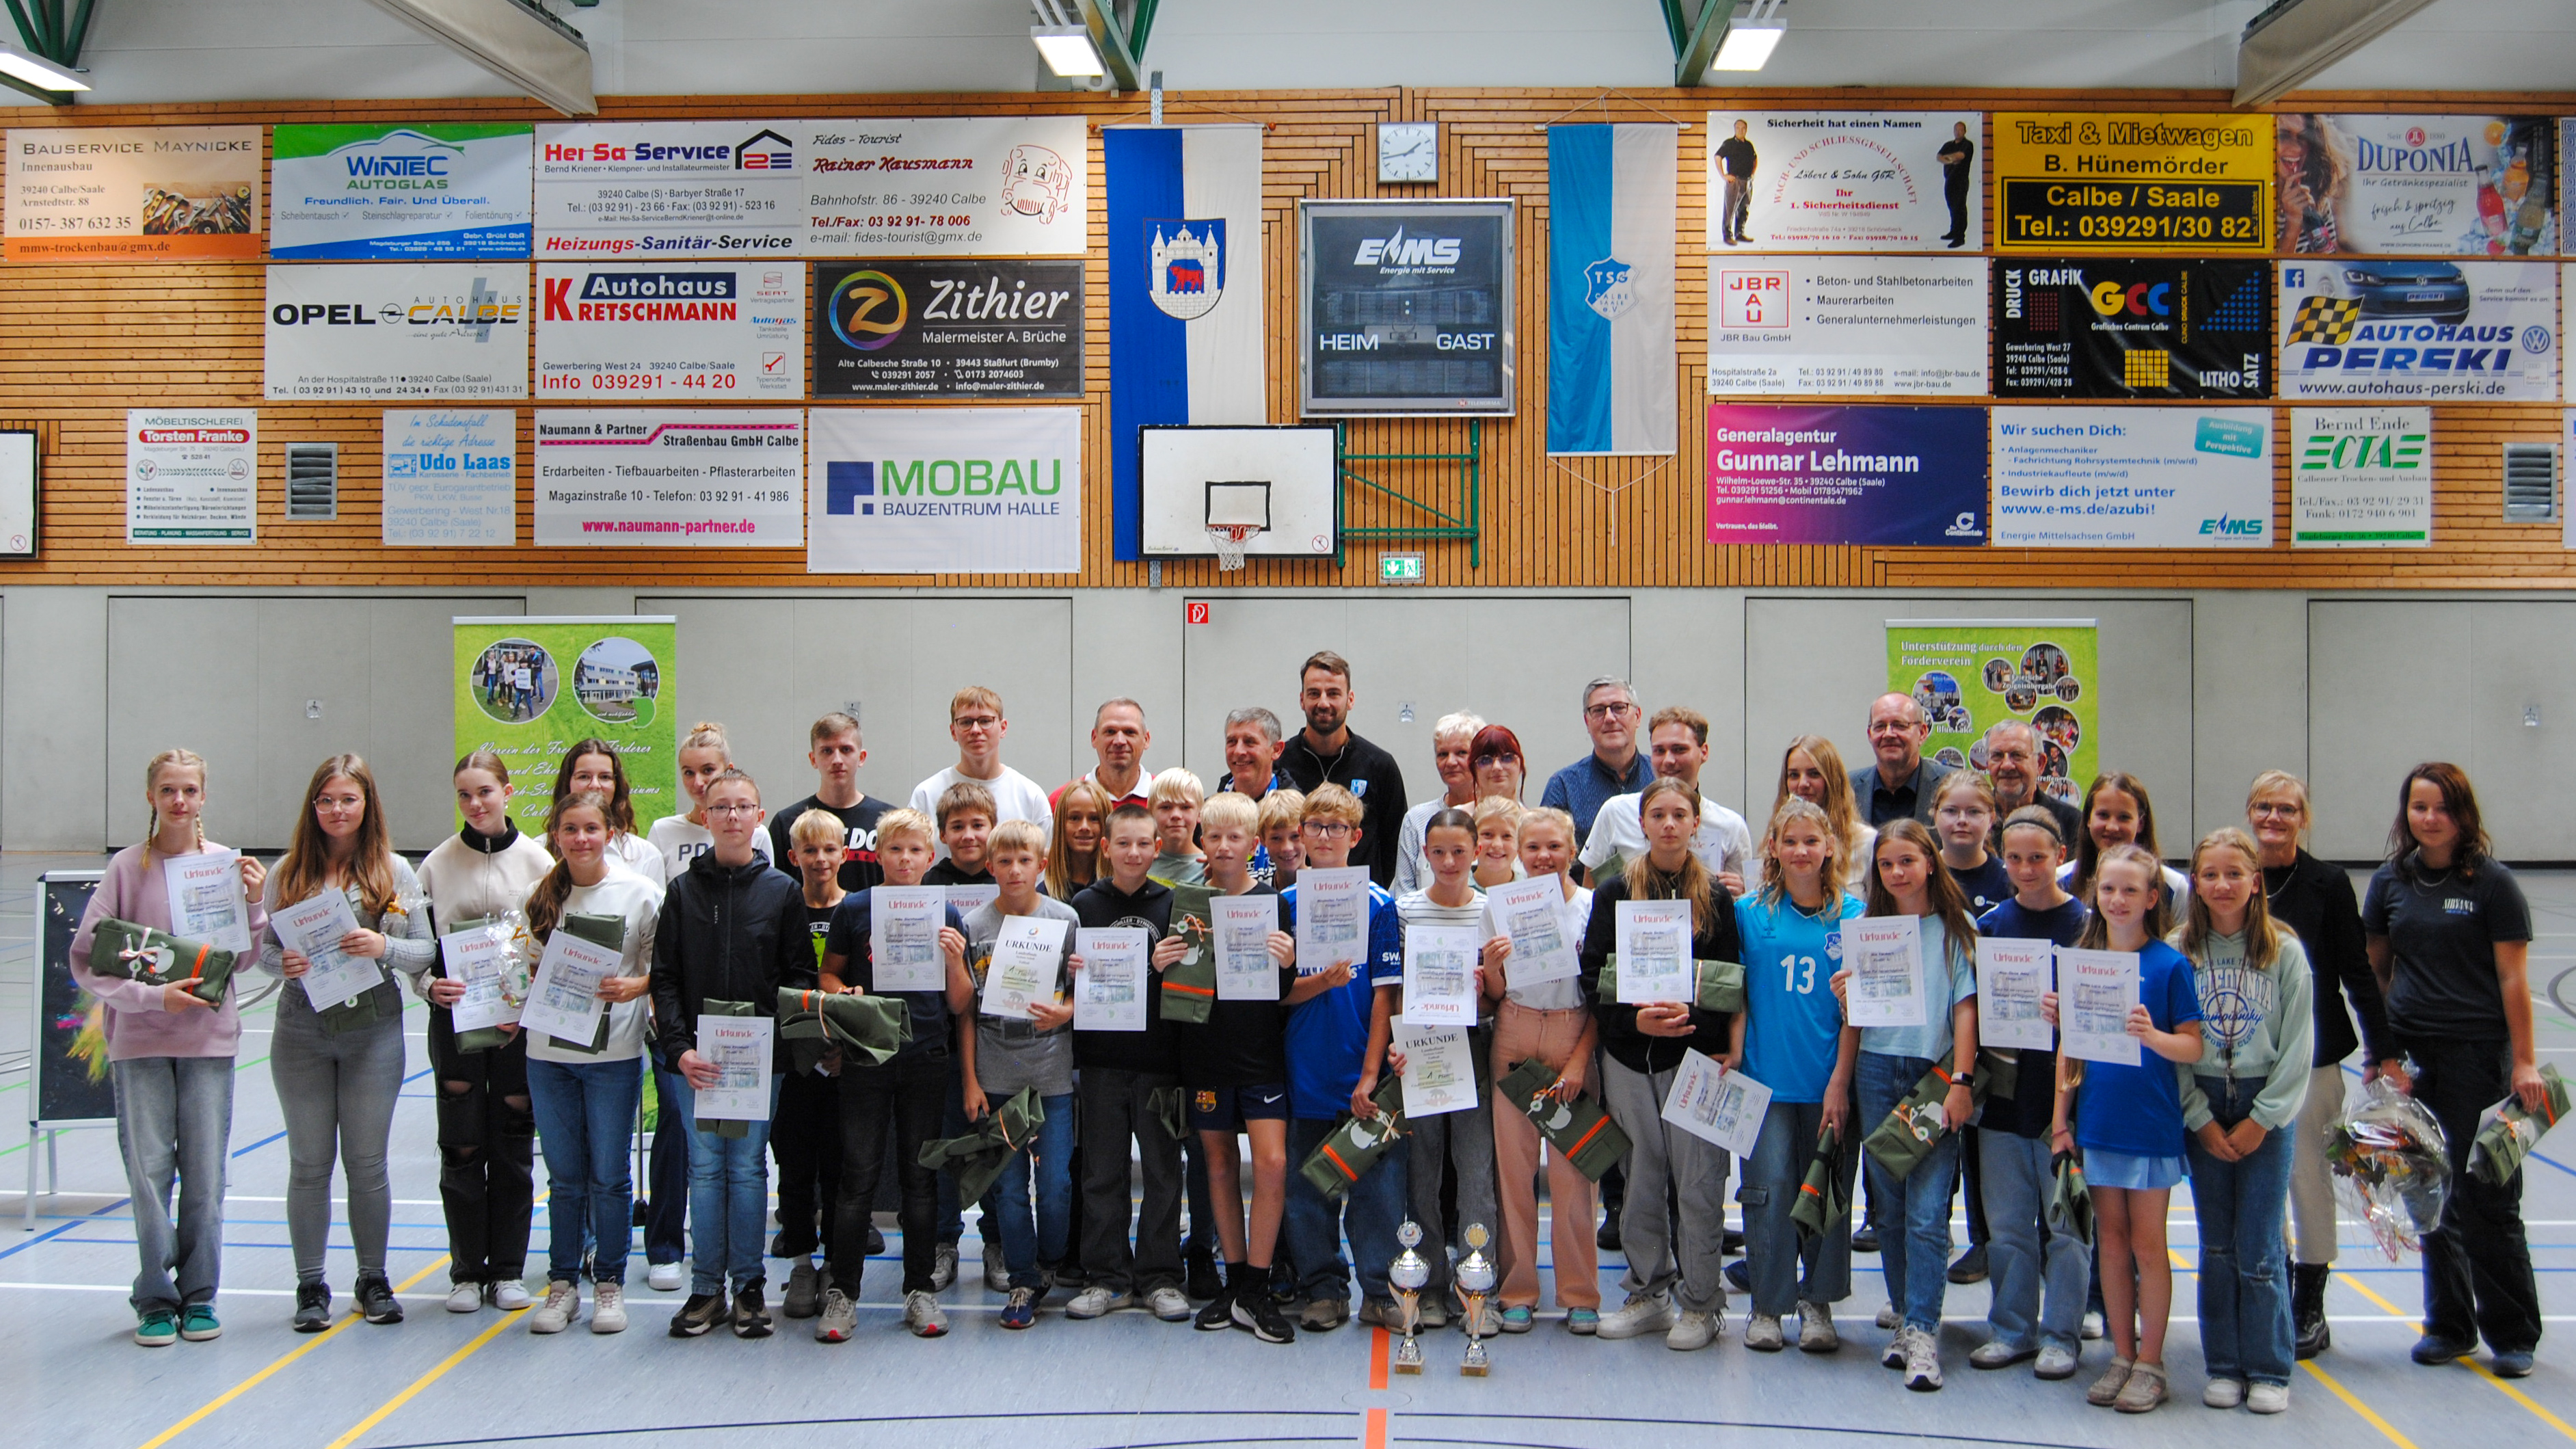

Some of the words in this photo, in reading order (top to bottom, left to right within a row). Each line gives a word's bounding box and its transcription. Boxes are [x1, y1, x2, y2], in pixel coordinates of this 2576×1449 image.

[1767, 120, 1824, 128] Sicherheit
[2016, 122, 2071, 145] Taxi
[2079, 123, 2101, 145] &
[2108, 122, 2253, 151] Mietwagen
[23, 143, 144, 155] BAUSERVICE
[155, 141, 252, 152] MAYNICKE
[2357, 136, 2476, 172] DUPONIA
[22, 162, 93, 172] Innenausbau
[813, 157, 875, 174] Rainer
[2044, 155, 2067, 172] B.
[2078, 155, 2228, 174] Hünemörder
[21, 186, 47, 194] 39240
[51, 185, 105, 194] Calbe/Saale
[347, 179, 448, 189] AUTOGLAS
[305, 197, 373, 205] Freundlich.
[443, 195, 489, 204] Überall.
[598, 190, 623, 198] 39240
[626, 189, 649, 198] Calbe
[651, 189, 662, 199] (S)
[669, 189, 702, 198] Barbyer
[705, 189, 732, 197] Straße
[735, 189, 744, 197] 17
[281, 211, 339, 220] Scheibentausch
[362, 211, 442, 220] Steinschlagreparatur
[546, 235, 792, 252] Heizungs-Sanitär-Service
[810, 233, 850, 243] e-mail:
[854, 231, 982, 244] fides-tourist@gmx.de
[1595, 271, 1628, 284] TSG
[1817, 276, 1851, 287] Beton-
[1854, 276, 1873, 287] und
[1877, 276, 1973, 287] Stahlbetonarbeiten
[2028, 269, 2082, 285] GRAFIK
[590, 276, 727, 296] Autohaus
[544, 278, 736, 321] KRETSCHMANN
[924, 276, 1069, 319] Zithier
[1817, 295, 1894, 306] Maurerarbeiten
[2006, 269, 2021, 318] DRUCK
[2092, 281, 2169, 316] GCC
[273, 304, 375, 325] OPEL
[408, 305, 521, 324] CALBE
[750, 316, 797, 325] Autogas
[1763, 334, 1790, 342] GmbH
[2355, 325, 2514, 342] AUTOHAUS
[1319, 334, 1379, 351] HEIM
[1436, 334, 1494, 350] GAST
[857, 359, 899, 367] Calbesche
[902, 359, 928, 367] Straße
[956, 359, 981, 367] 39443
[984, 358, 1017, 367] Staßfurt
[1020, 358, 1059, 368] (Brumby)
[2301, 347, 2512, 376] PERSKI
[2244, 354, 2258, 388] SATZ
[543, 375, 580, 389] Info
[593, 375, 663, 389] 039291
[683, 374, 706, 388] 44
[712, 374, 736, 388] 20
[2199, 371, 2240, 387] LITHO
[2299, 382, 2505, 397] www.autohaus-perski.de
[145, 416, 243, 425] MÖBELTISCHLEREI
[2315, 417, 2363, 430] Bernd
[2370, 416, 2410, 429] Ende
[145, 431, 194, 442] Torsten
[198, 431, 244, 441] Franke
[540, 425, 590, 435] Naumann
[595, 425, 602, 434] &
[606, 424, 647, 434] Partner
[2001, 425, 2026, 436] Wir
[2032, 425, 2083, 436] suchen
[2089, 425, 2126, 436] Dich:
[663, 436, 727, 447] Straßenbau
[731, 436, 763, 447] GmbH
[767, 435, 799, 446] Calbe
[1717, 428, 1836, 446] Generalagentur
[420, 454, 455, 470] Udo
[464, 453, 510, 470] Laas
[1717, 449, 1804, 472] Gunnar
[1810, 449, 1919, 472] Lehmann
[882, 459, 1060, 496] MOBAU
[2001, 486, 2054, 497] Bewirb
[2059, 486, 2091, 496] dich
[2095, 486, 2129, 500] jetzt
[2134, 487, 2175, 497] unter
[883, 503, 1000, 516] BAUZENTRUM
[1008, 502, 1060, 515] HALLE
[582, 519, 755, 535] www.naumann-partner.de
[1901, 641, 1976, 652] Unterstützung
[1978, 643, 2004, 652] durch
[1901, 656, 1971, 666] Förderverein
[479, 742, 519, 755] Verein
[521, 742, 540, 754] der
[679, 843, 710, 860] PO
[185, 867, 224, 879] Urkunde
[1313, 881, 1352, 890] Urkunde
[889, 901, 927, 909] Urkunde
[1505, 891, 1544, 906] Urkunde
[293, 908, 332, 928] Urkunde
[1226, 910, 1261, 919] Urkunde
[1633, 914, 1673, 923] Urkunde
[1859, 931, 1901, 941] Urkunde
[1006, 940, 1052, 952] URKUNDE
[1092, 942, 1129, 950] Urkunde
[563, 946, 602, 966] Urkunde
[1993, 953, 2033, 963] Urkunde
[1780, 955, 1816, 994] 13
[2076, 964, 2119, 976] Urkunde
[714, 1028, 755, 1038] Urkunde
[2238, 1028, 2255, 1046] CLUB
[1406, 1033, 1458, 1048] URKUNDE
[1678, 1071, 1699, 1108] Urkunde
